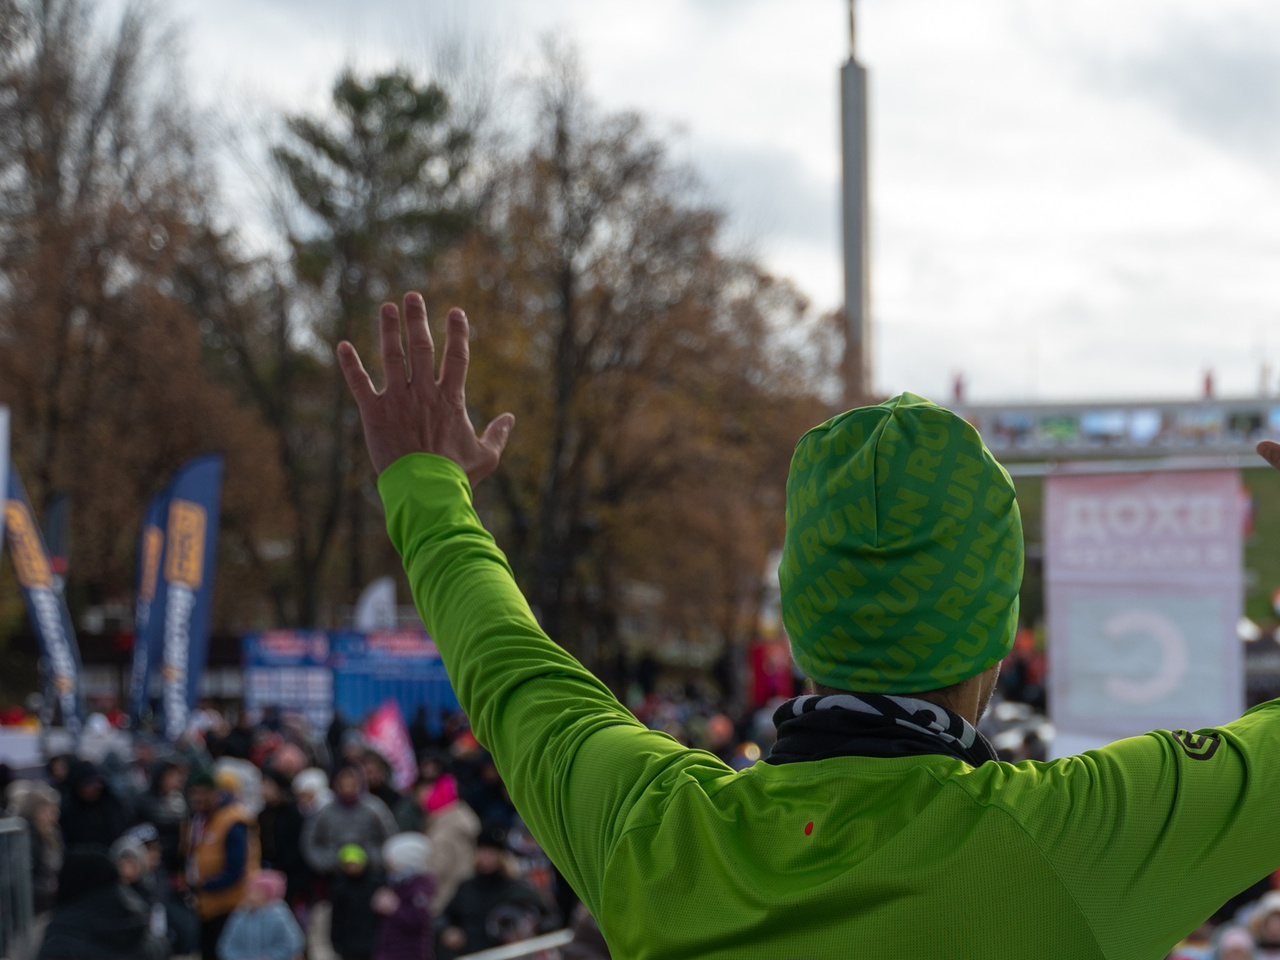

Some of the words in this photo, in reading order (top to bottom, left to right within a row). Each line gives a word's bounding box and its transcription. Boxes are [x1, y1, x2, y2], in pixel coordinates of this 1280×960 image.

[801, 496, 877, 566] RUN
[929, 452, 985, 551] RUN
[795, 557, 868, 629] RUN
[850, 551, 946, 639] RUN
[933, 521, 999, 621] RUN
[846, 620, 947, 692] RUN
[929, 590, 1010, 686] RUN
